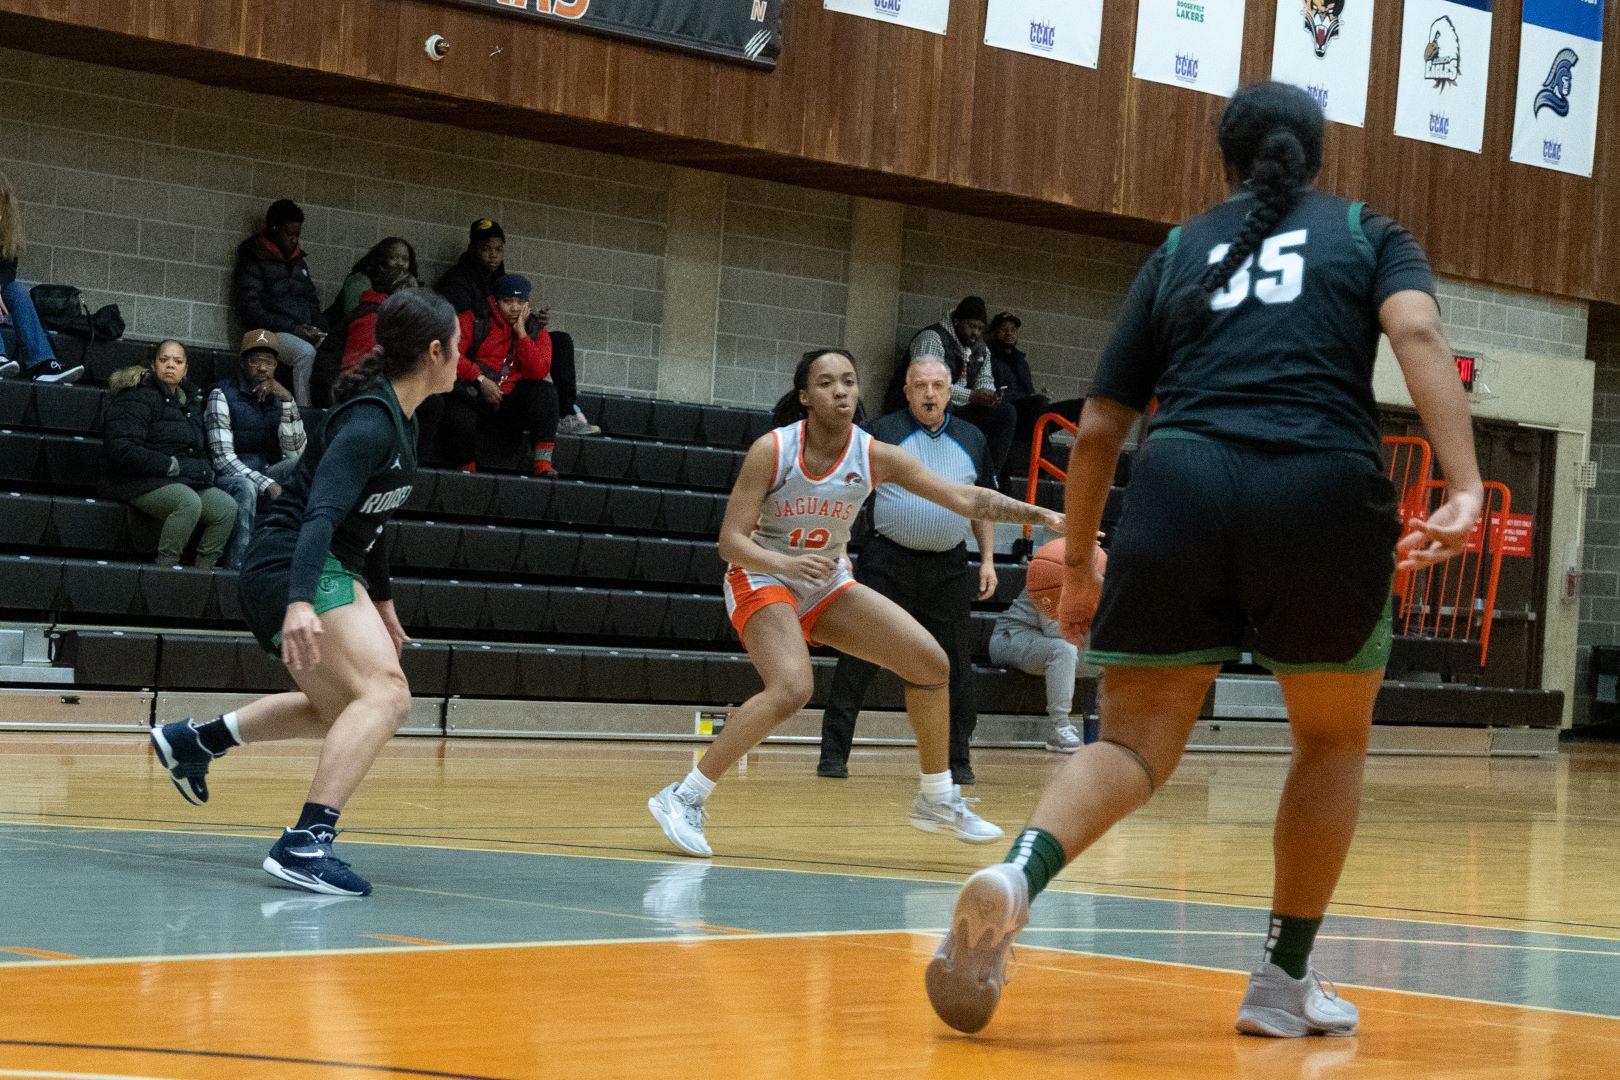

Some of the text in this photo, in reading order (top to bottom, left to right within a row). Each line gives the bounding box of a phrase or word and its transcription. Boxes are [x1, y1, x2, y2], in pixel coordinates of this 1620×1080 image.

[1176, 8, 1204, 23] LAKERS
[1030, 24, 1055, 46] CCAC
[1175, 56, 1198, 78] CCAC
[1429, 115, 1449, 135] CCAC
[1543, 142, 1561, 160] CCAC
[775, 496, 855, 521] JAGUARS
[788, 528, 832, 550] 12
